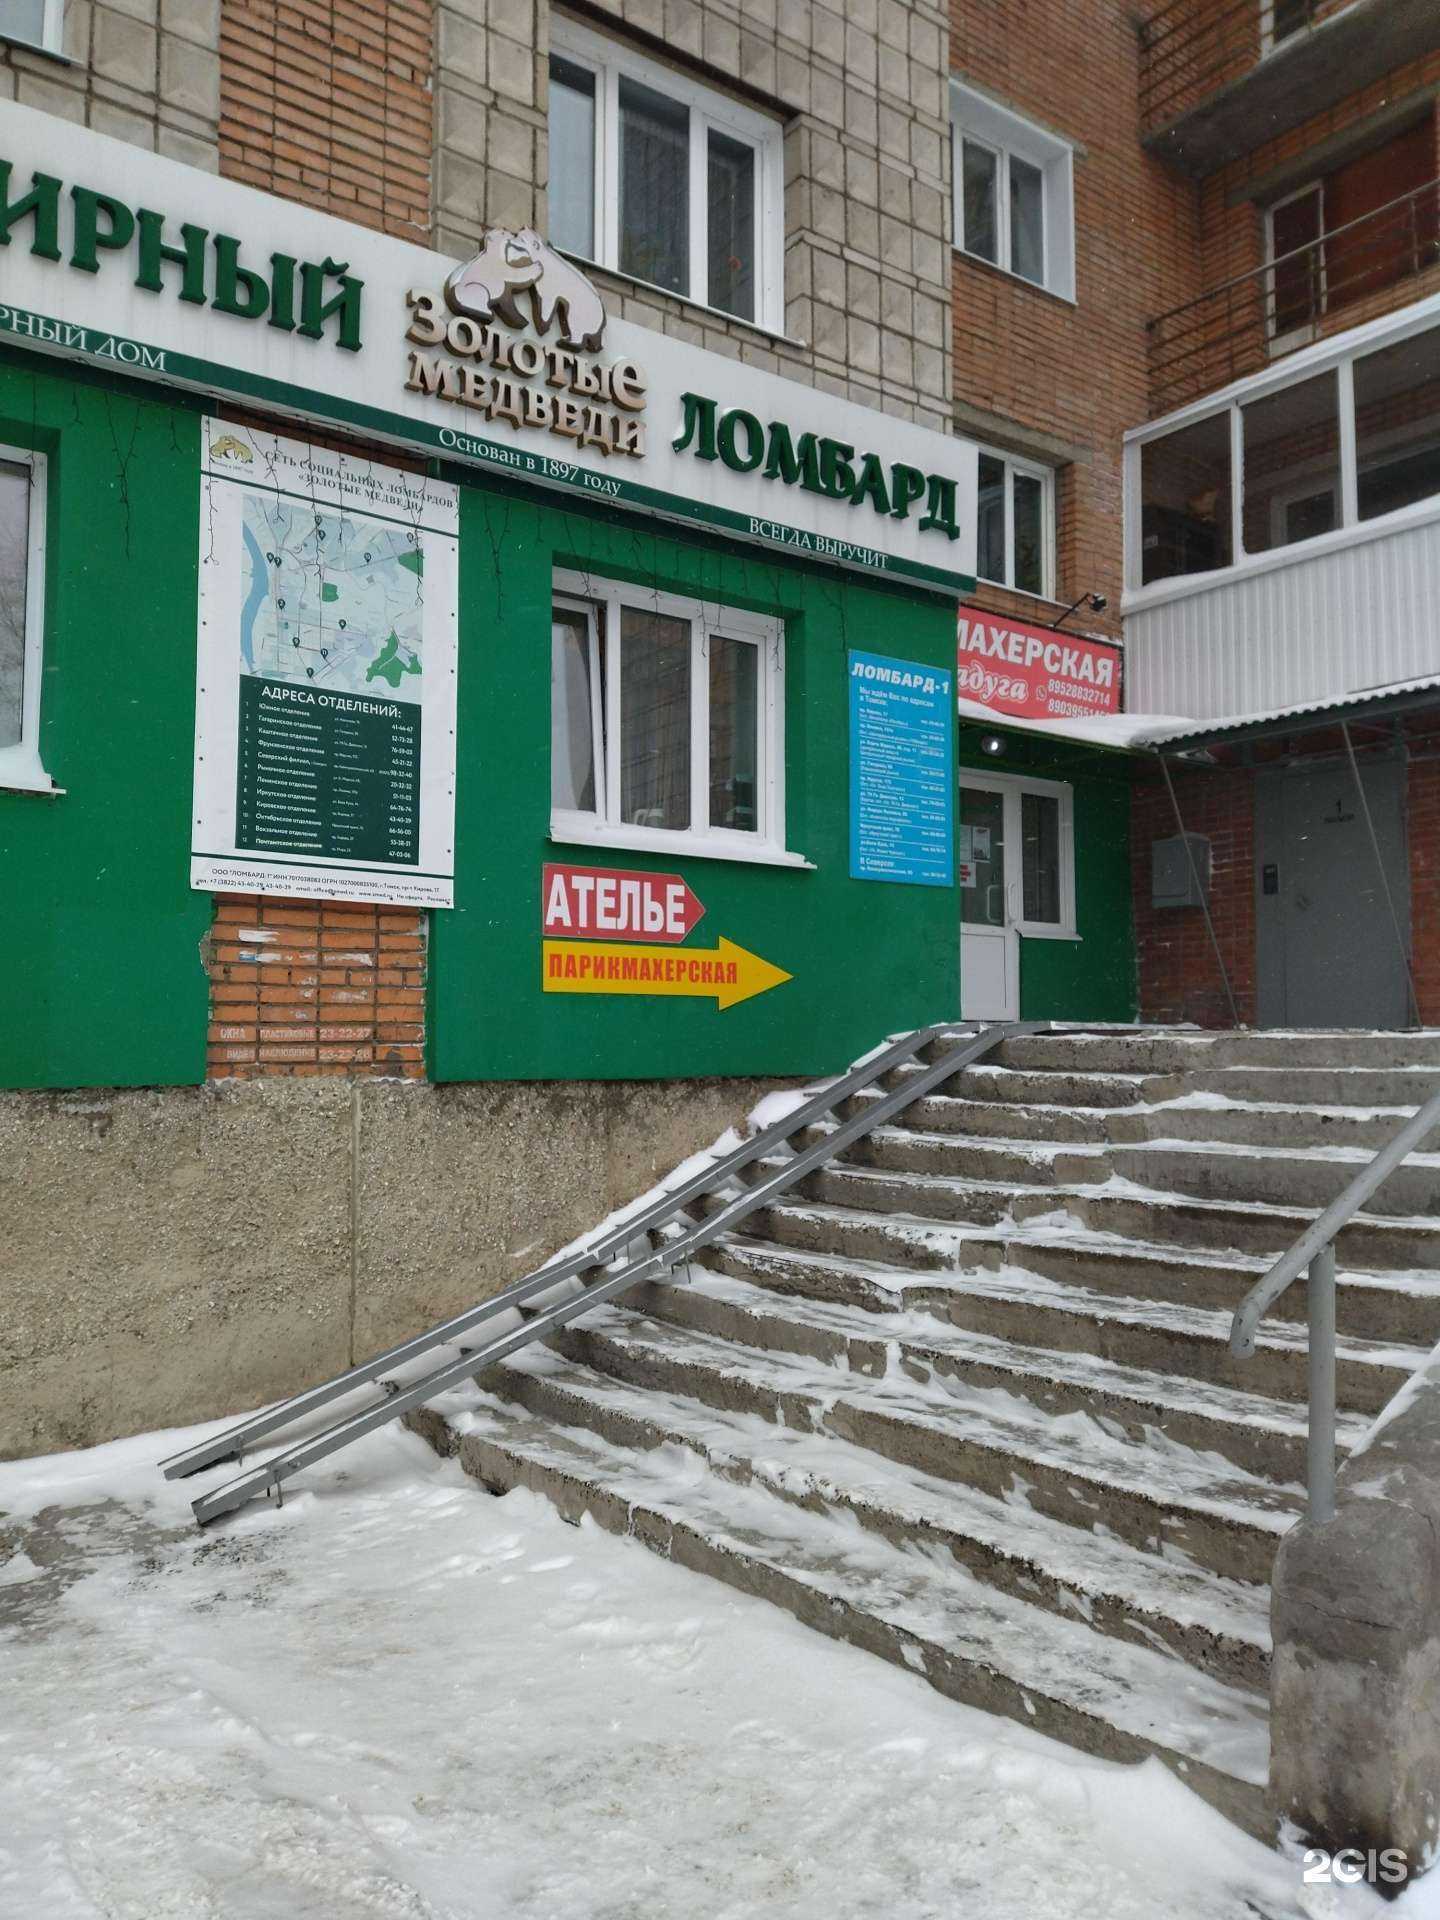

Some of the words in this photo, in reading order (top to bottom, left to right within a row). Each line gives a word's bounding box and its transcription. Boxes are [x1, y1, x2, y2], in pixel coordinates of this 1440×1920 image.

[0, 158, 364, 352] ИРНЫЙ
[95, 337, 167, 371] ДОМ
[404, 350, 647, 459] МЕДВЕДИ
[265, 451, 296, 467] СЕТЬ
[300, 459, 383, 490] СОЦИАЛЬНЫХ
[386, 483, 453, 509] ЛОМБАРДОВ
[439, 427, 521, 466] Основан
[526, 457, 535, 469] в
[541, 457, 578, 481] 1897
[584, 473, 621, 497] году
[671, 391, 960, 541] ЛОМБАРД
[750, 518, 811, 549] ВСЕГДА
[816, 535, 888, 569] ВЫРУЧИТ
[261, 686, 316, 704] АДРЕСА
[318, 695, 401, 718] ОТДЕЛЕНИЙ:
[851, 662, 949, 694] ЛОМБАРД-1
[545, 873, 686, 934] АТЕЛЬЕ
[549, 953, 738, 984] ПАРИКМАХЕРСКАЯ
